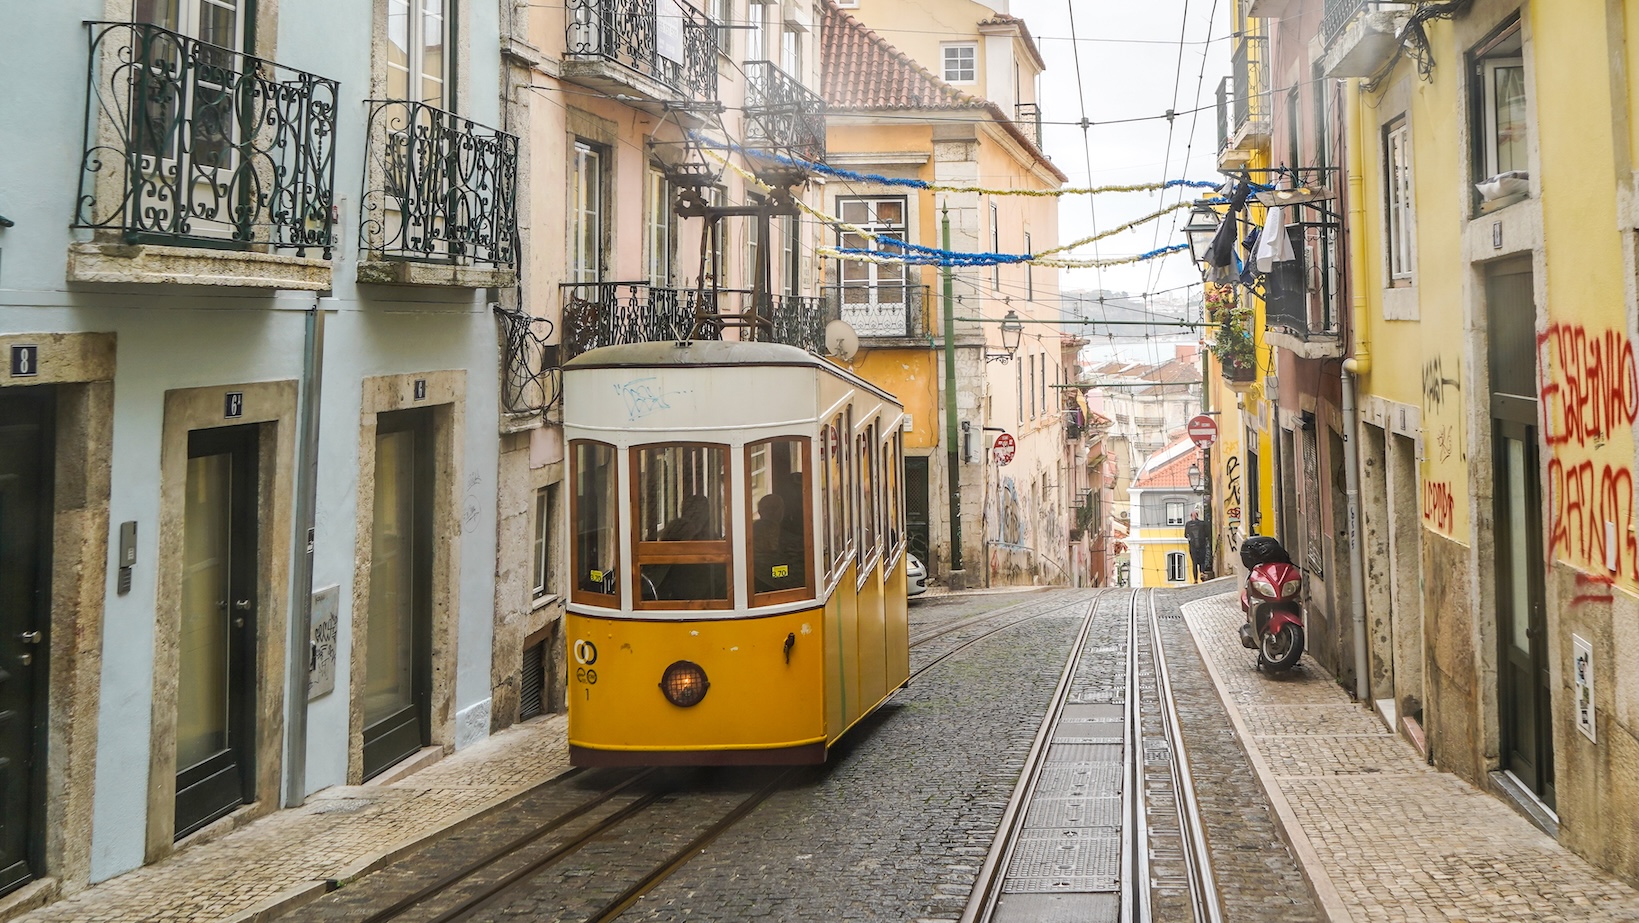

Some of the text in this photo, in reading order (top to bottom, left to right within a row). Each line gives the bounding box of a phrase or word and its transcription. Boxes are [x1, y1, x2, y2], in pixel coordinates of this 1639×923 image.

[20, 348, 29, 374] 8
[418, 381, 423, 398] 6
[1538, 322, 1638, 448] ESPINHO
[585, 688, 590, 701] 1
